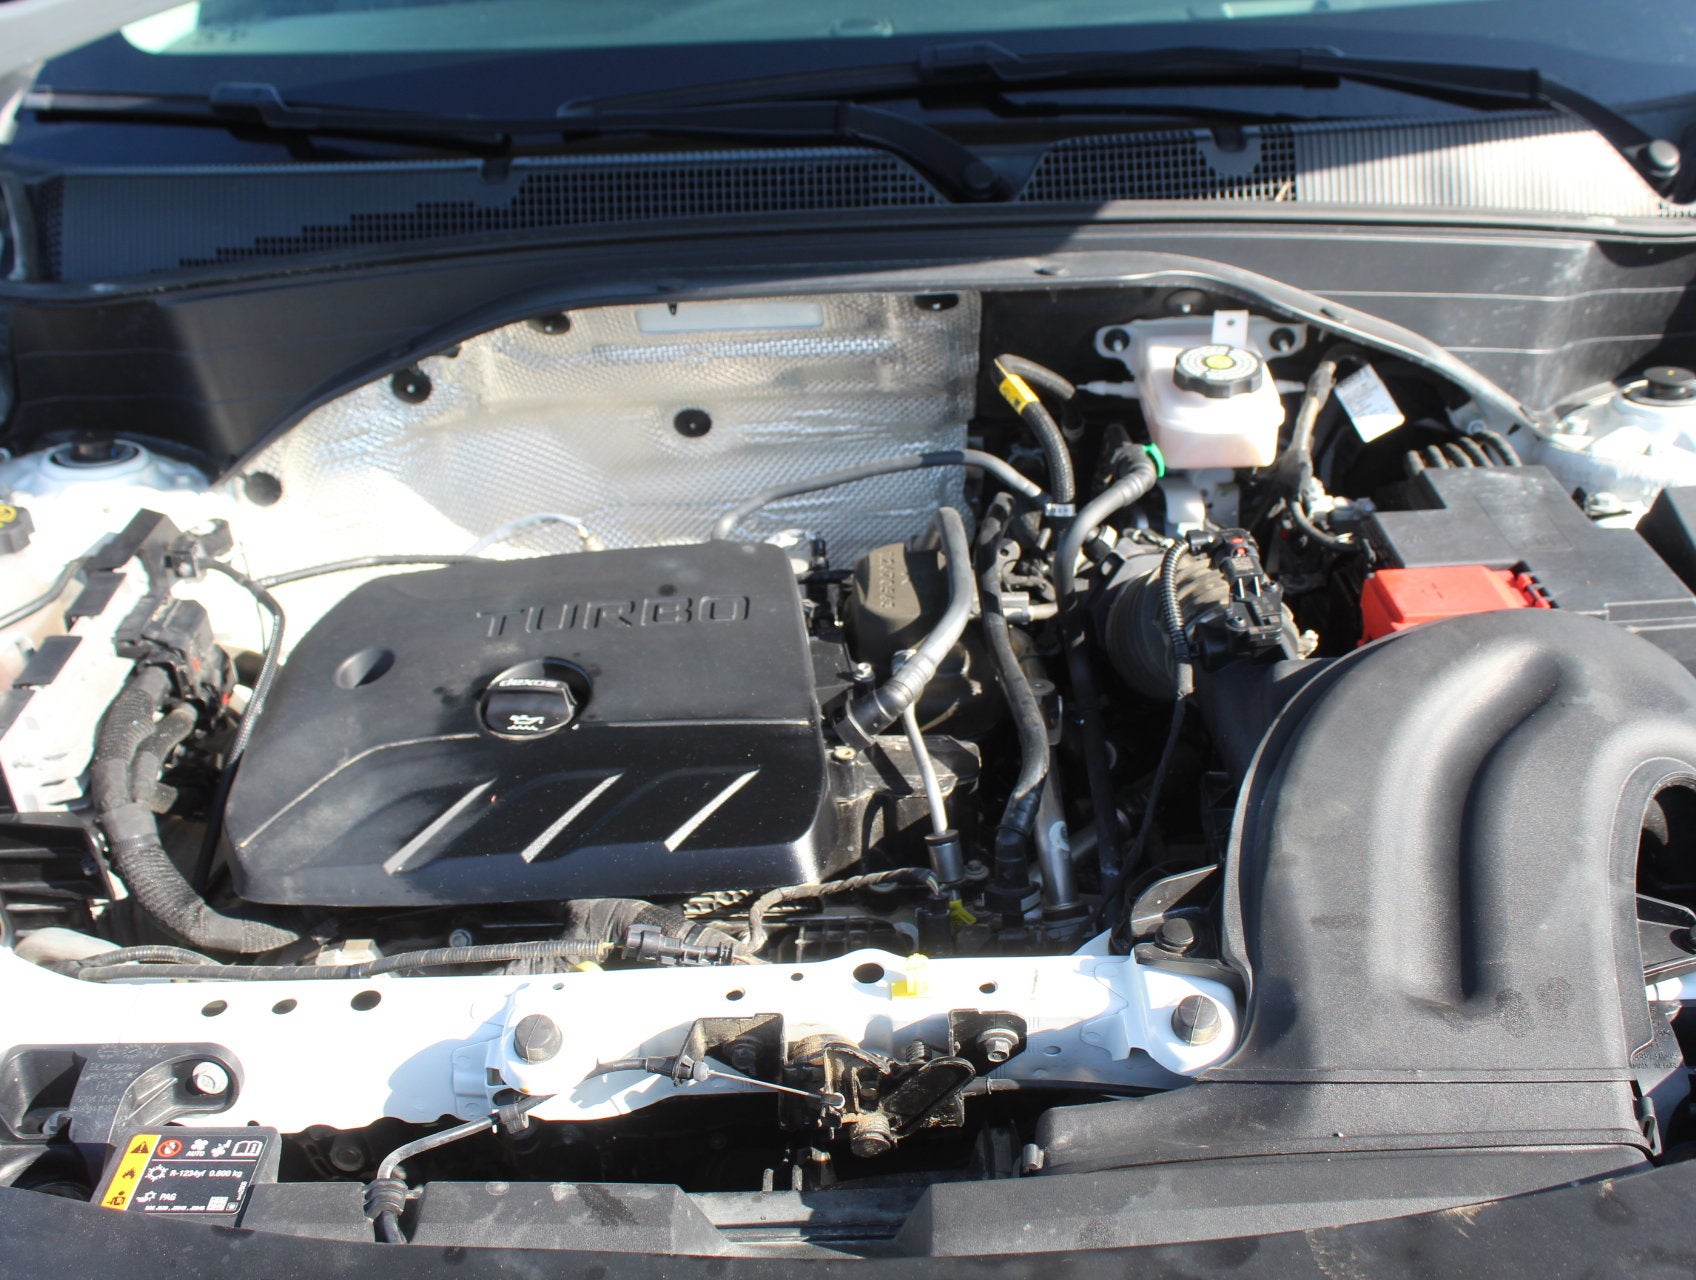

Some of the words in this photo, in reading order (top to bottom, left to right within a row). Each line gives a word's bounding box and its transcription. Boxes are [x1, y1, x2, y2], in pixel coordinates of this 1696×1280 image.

[476, 595, 750, 637] TURBO
[499, 677, 558, 688] dexos
[169, 1169, 206, 1179] R-1234yf
[231, 1169, 243, 1179] kg
[159, 1192, 177, 1201] PAG
